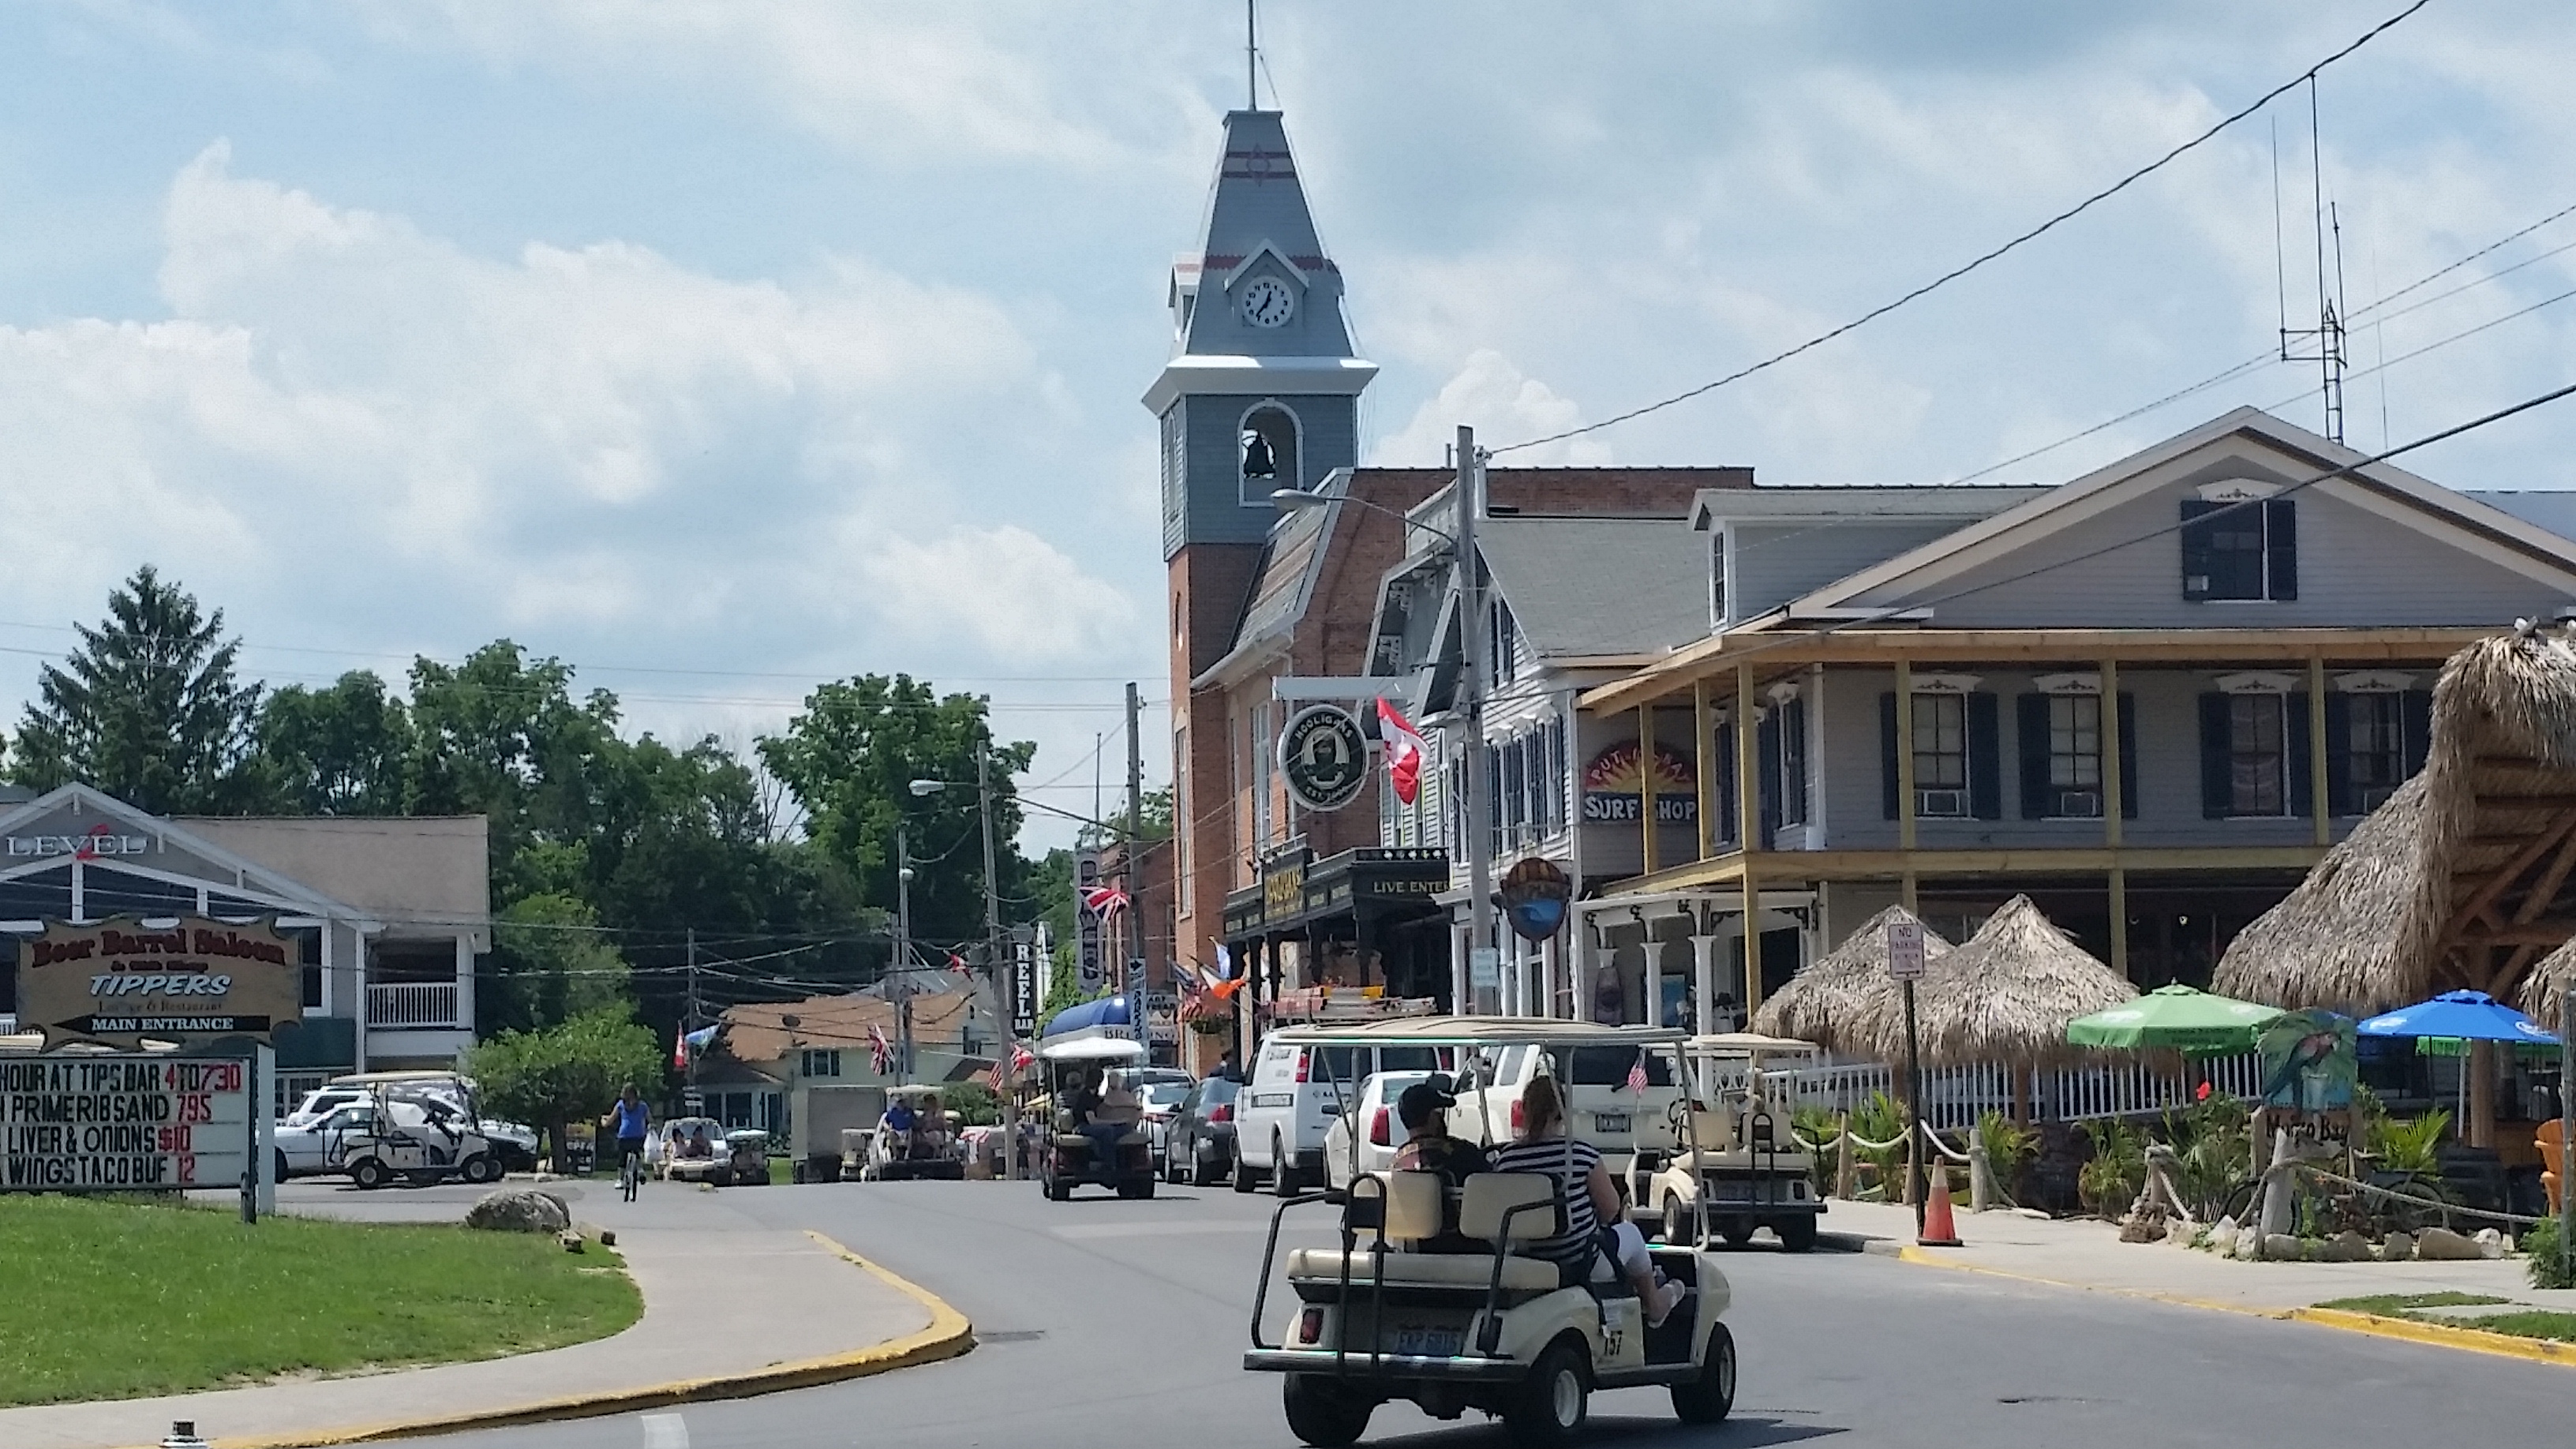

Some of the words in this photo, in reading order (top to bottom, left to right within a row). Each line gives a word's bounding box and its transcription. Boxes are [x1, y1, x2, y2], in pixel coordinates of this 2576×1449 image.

[1294, 715, 1354, 739] HOOLIGANS
[1585, 796, 1638, 819] SURF
[1657, 799, 1697, 820] HOP
[6, 835, 148, 856] LEVEL
[1374, 881, 1405, 893] LIVE
[32, 940, 95, 968] Beer
[101, 928, 188, 956] Barrel
[194, 928, 286, 965] Saloon
[90, 974, 232, 996] TIPPERS
[1016, 944, 1031, 1017] REEL
[92, 1018, 137, 1031] MAIN
[142, 1017, 234, 1030] ENTRANCE
[1014, 1018, 1034, 1031] BAR
[50, 1065, 73, 1091] AT
[164, 1063, 174, 1090] 4
[200, 1063, 241, 1091] 730
[177, 1095, 212, 1121] 795
[8, 1126, 62, 1154] LIVER
[66, 1126, 77, 1153] &
[84, 1126, 155, 1152] ONIONS
[158, 1125, 191, 1152] $10
[178, 1155, 196, 1182] 12
